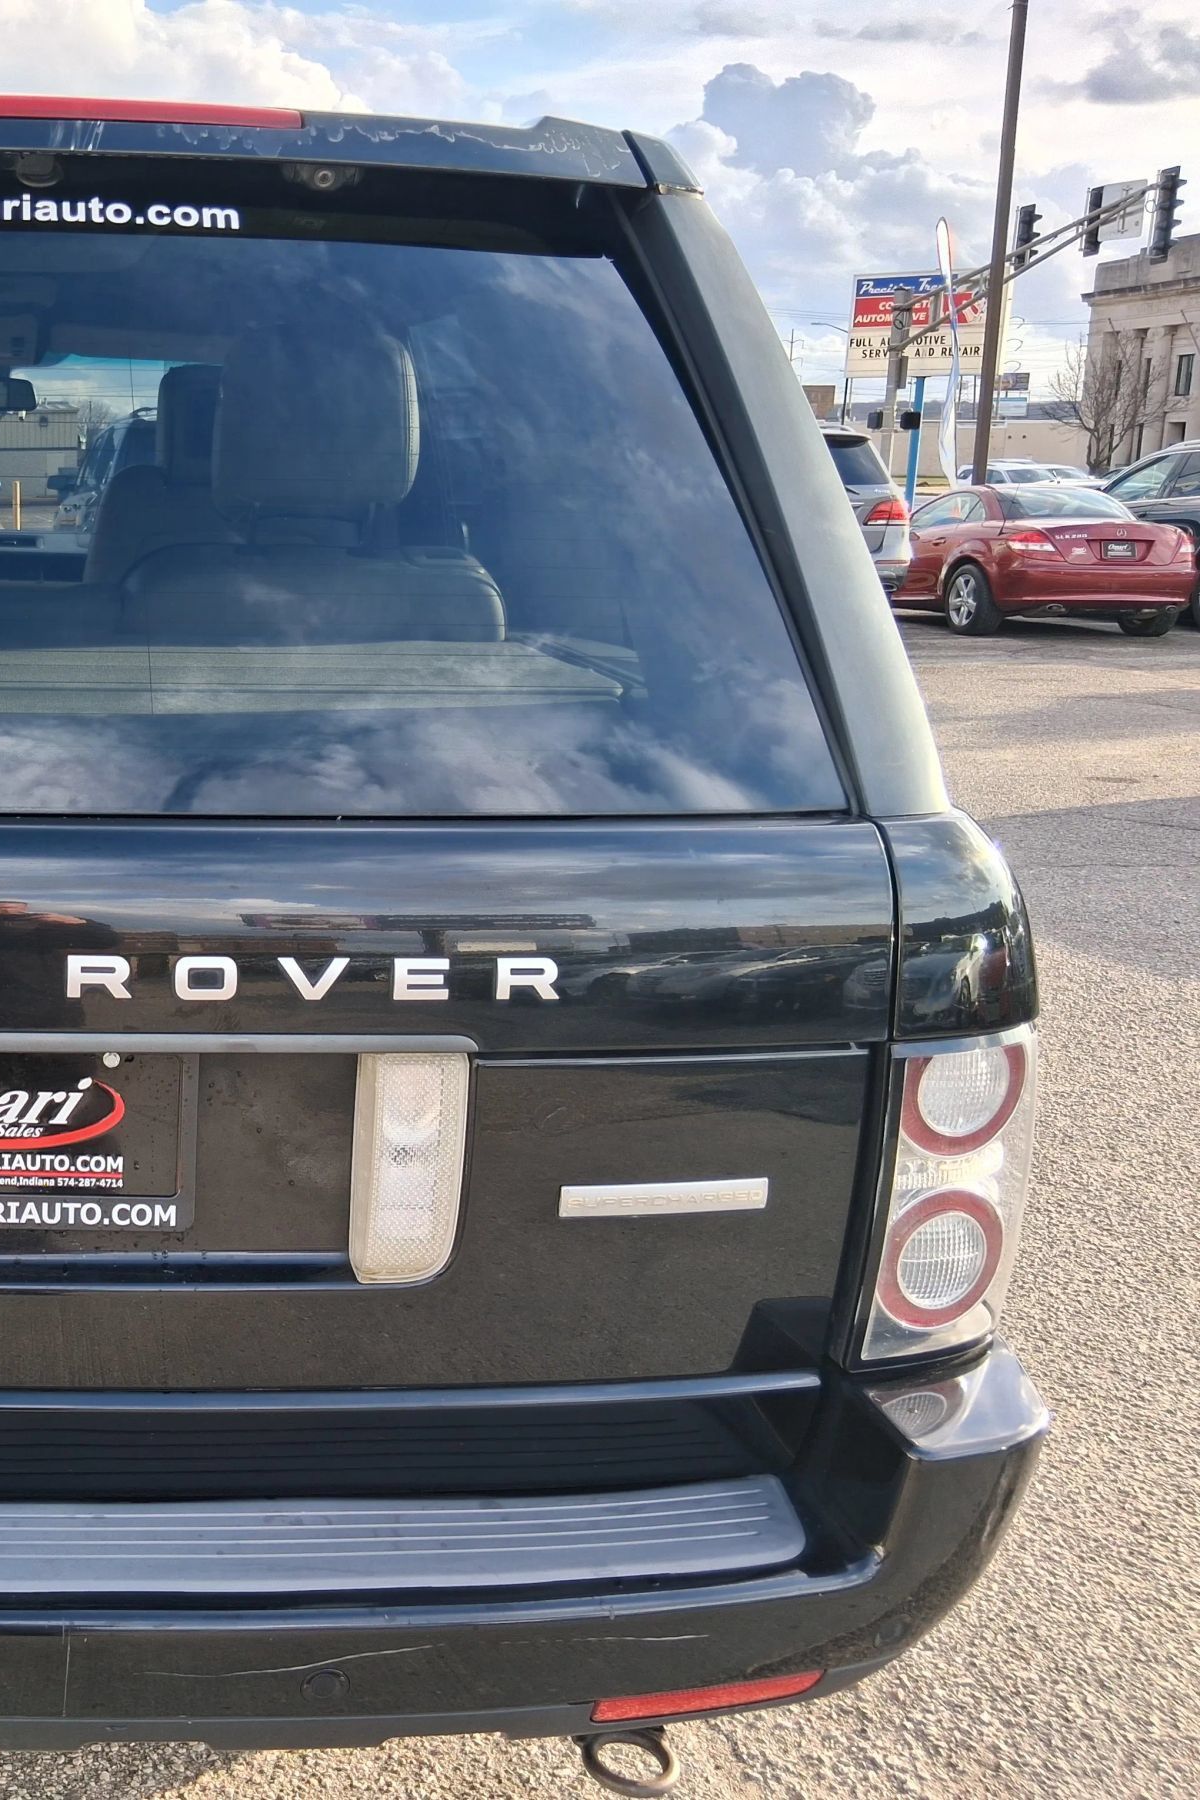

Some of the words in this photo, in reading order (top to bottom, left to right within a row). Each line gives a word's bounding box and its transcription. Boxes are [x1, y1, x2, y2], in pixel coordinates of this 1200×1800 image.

[879, 300, 932, 311] COET
[855, 312, 926, 323] AUTOMVE
[850, 338, 873, 347] FULL
[880, 335, 946, 347] AOTIVE
[862, 348, 906, 358] SERV
[941, 346, 980, 357] REAIR
[67, 954, 560, 1000] ROVER
[57, 1178, 123, 1188] 574-287-4714
[566, 1189, 763, 1209] SUPERCHARGED
